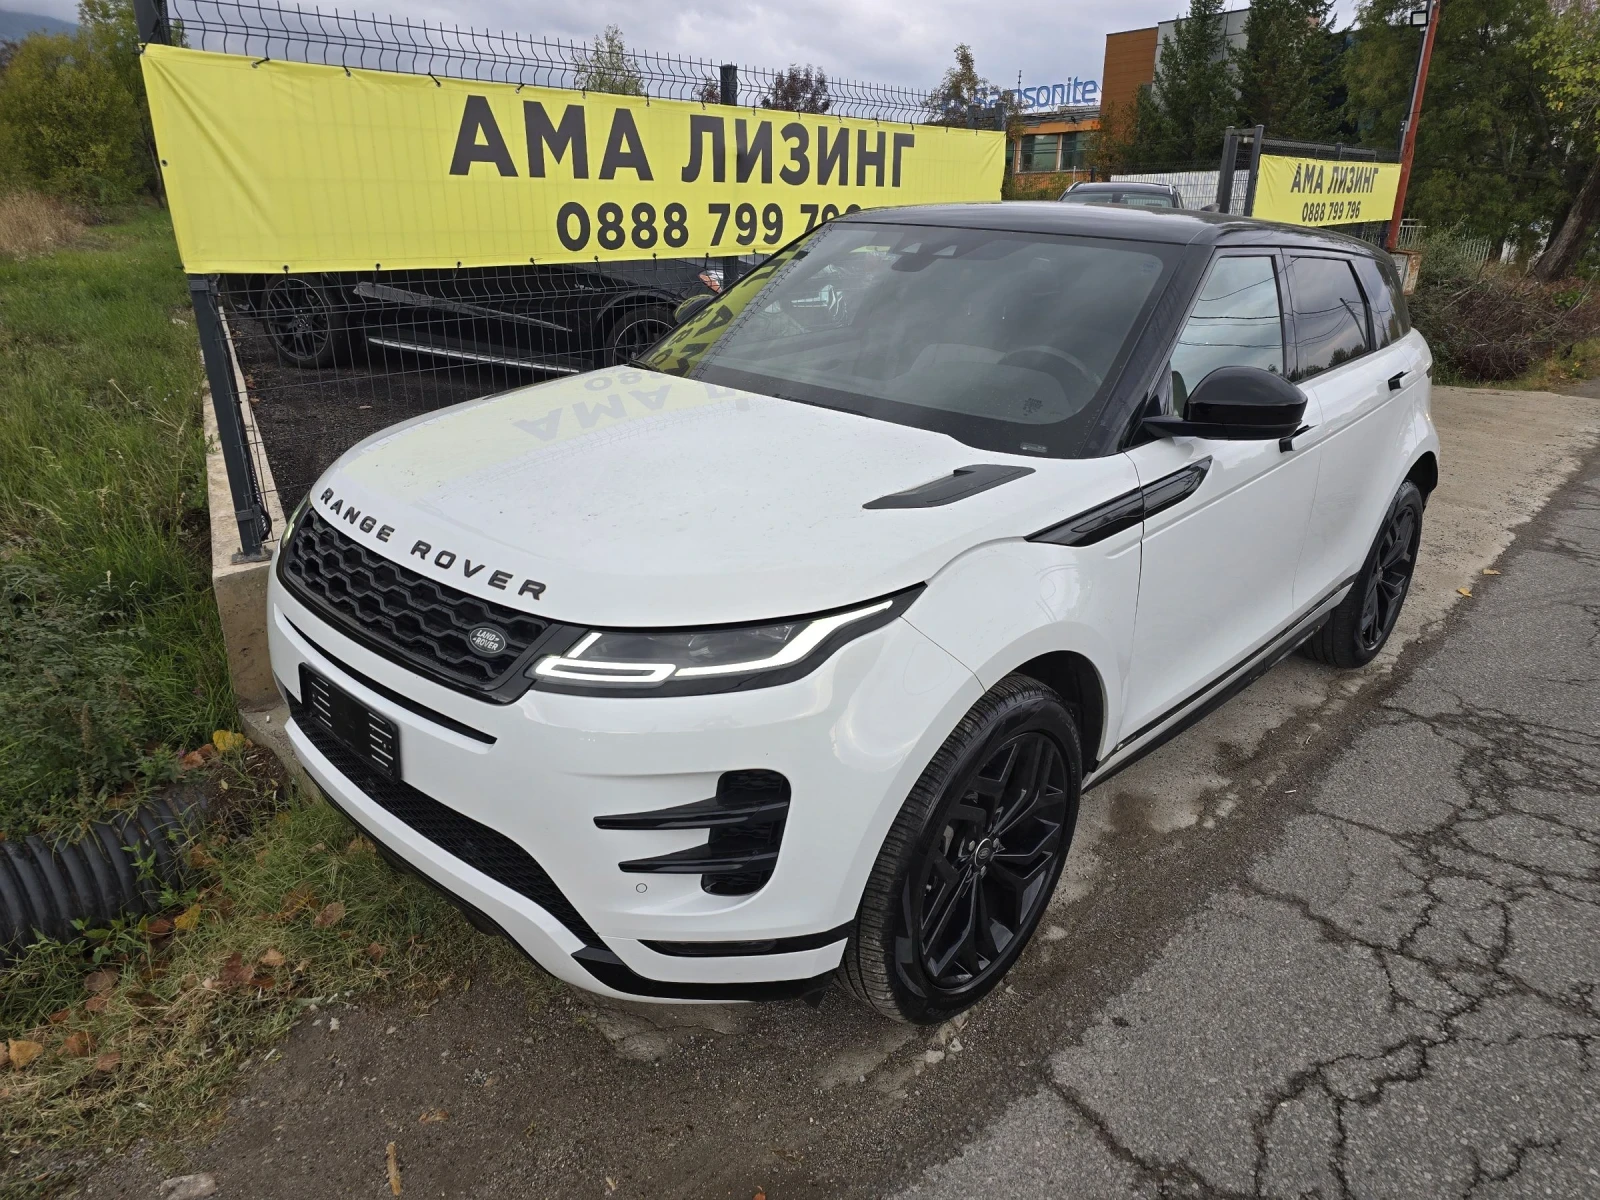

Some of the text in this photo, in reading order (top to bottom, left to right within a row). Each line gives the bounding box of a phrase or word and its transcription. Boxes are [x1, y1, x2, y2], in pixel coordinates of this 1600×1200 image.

[449, 95, 915, 188] АМА ЛИЗИНГ
[1290, 162, 1379, 194] АМА ЛИЗИНГ
[556, 201, 690, 252] 0888
[708, 202, 784, 245] 799
[1302, 201, 1361, 222] 0888 799 796
[320, 487, 547, 600] RANGE ROVER
[475, 637, 498, 650] ROVER
[476, 630, 496, 641] LAND
